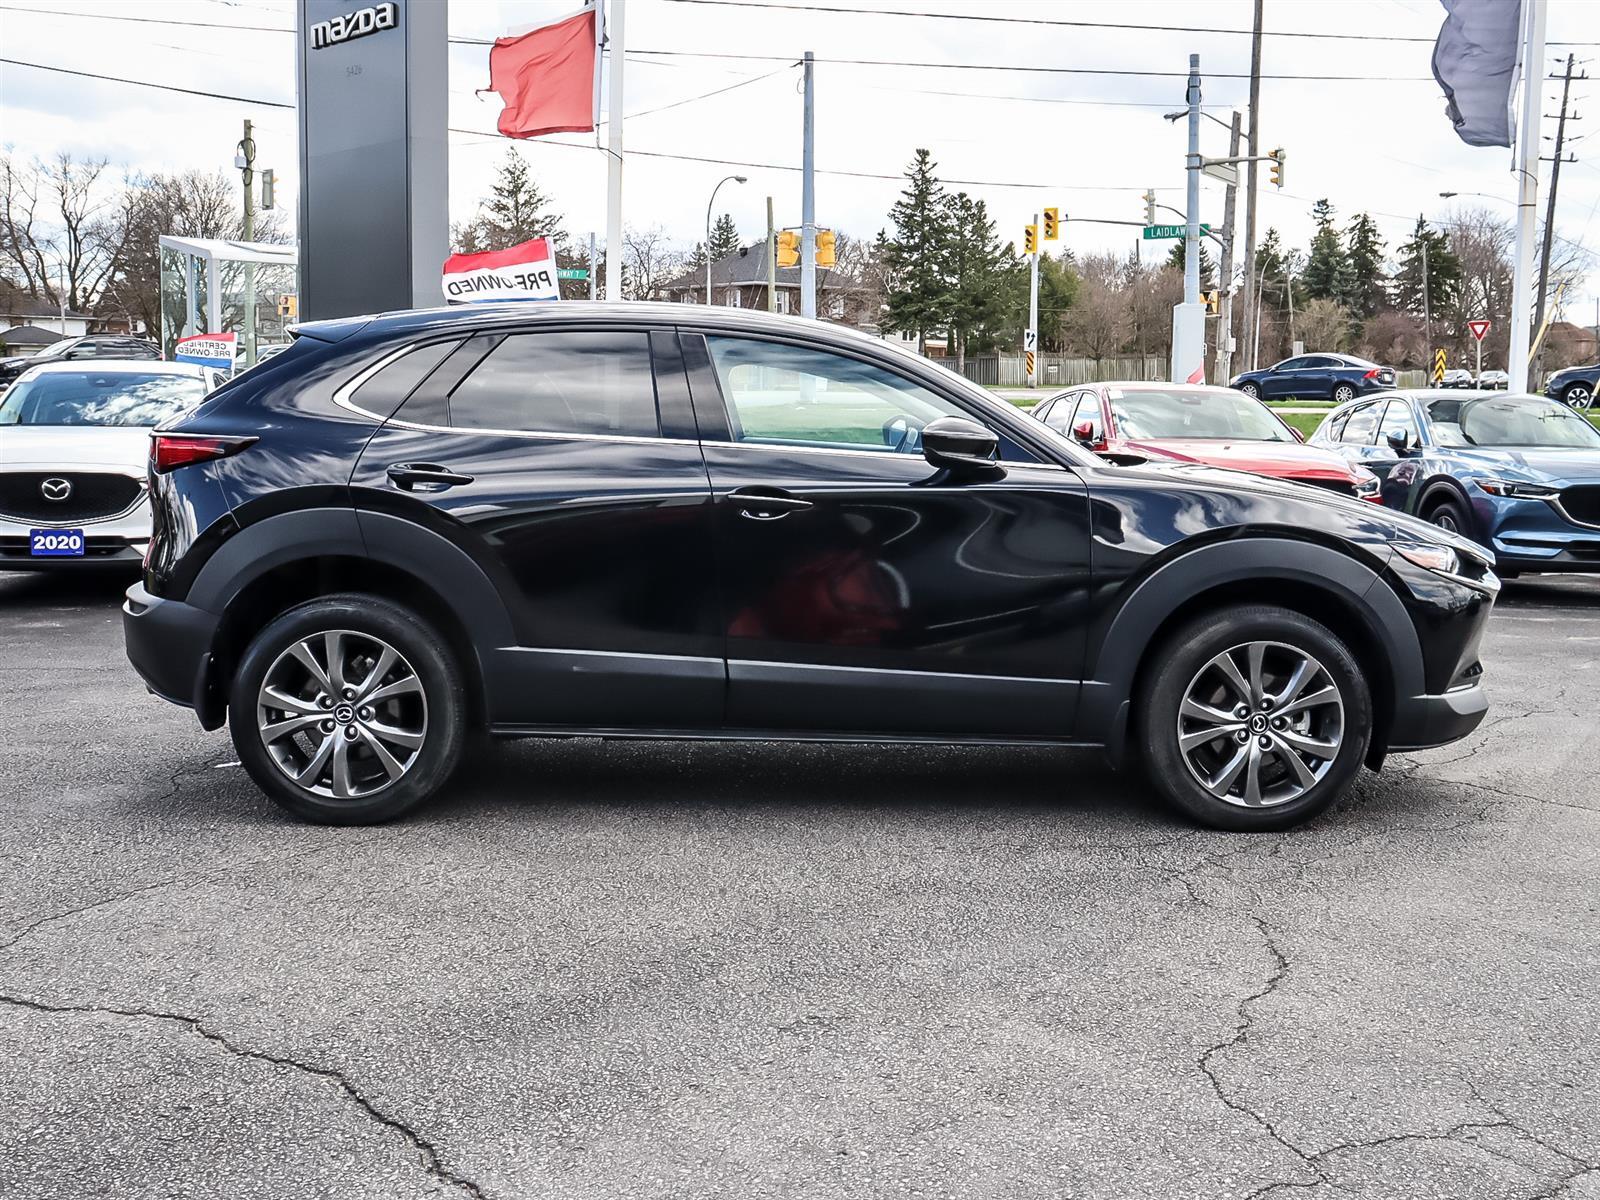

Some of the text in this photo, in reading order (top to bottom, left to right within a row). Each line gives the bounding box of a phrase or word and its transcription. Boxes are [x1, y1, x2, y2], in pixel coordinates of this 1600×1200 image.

[310, 2, 396, 48] mazda
[575, 270, 580, 279] 7
[33, 535, 81, 550] 2020
